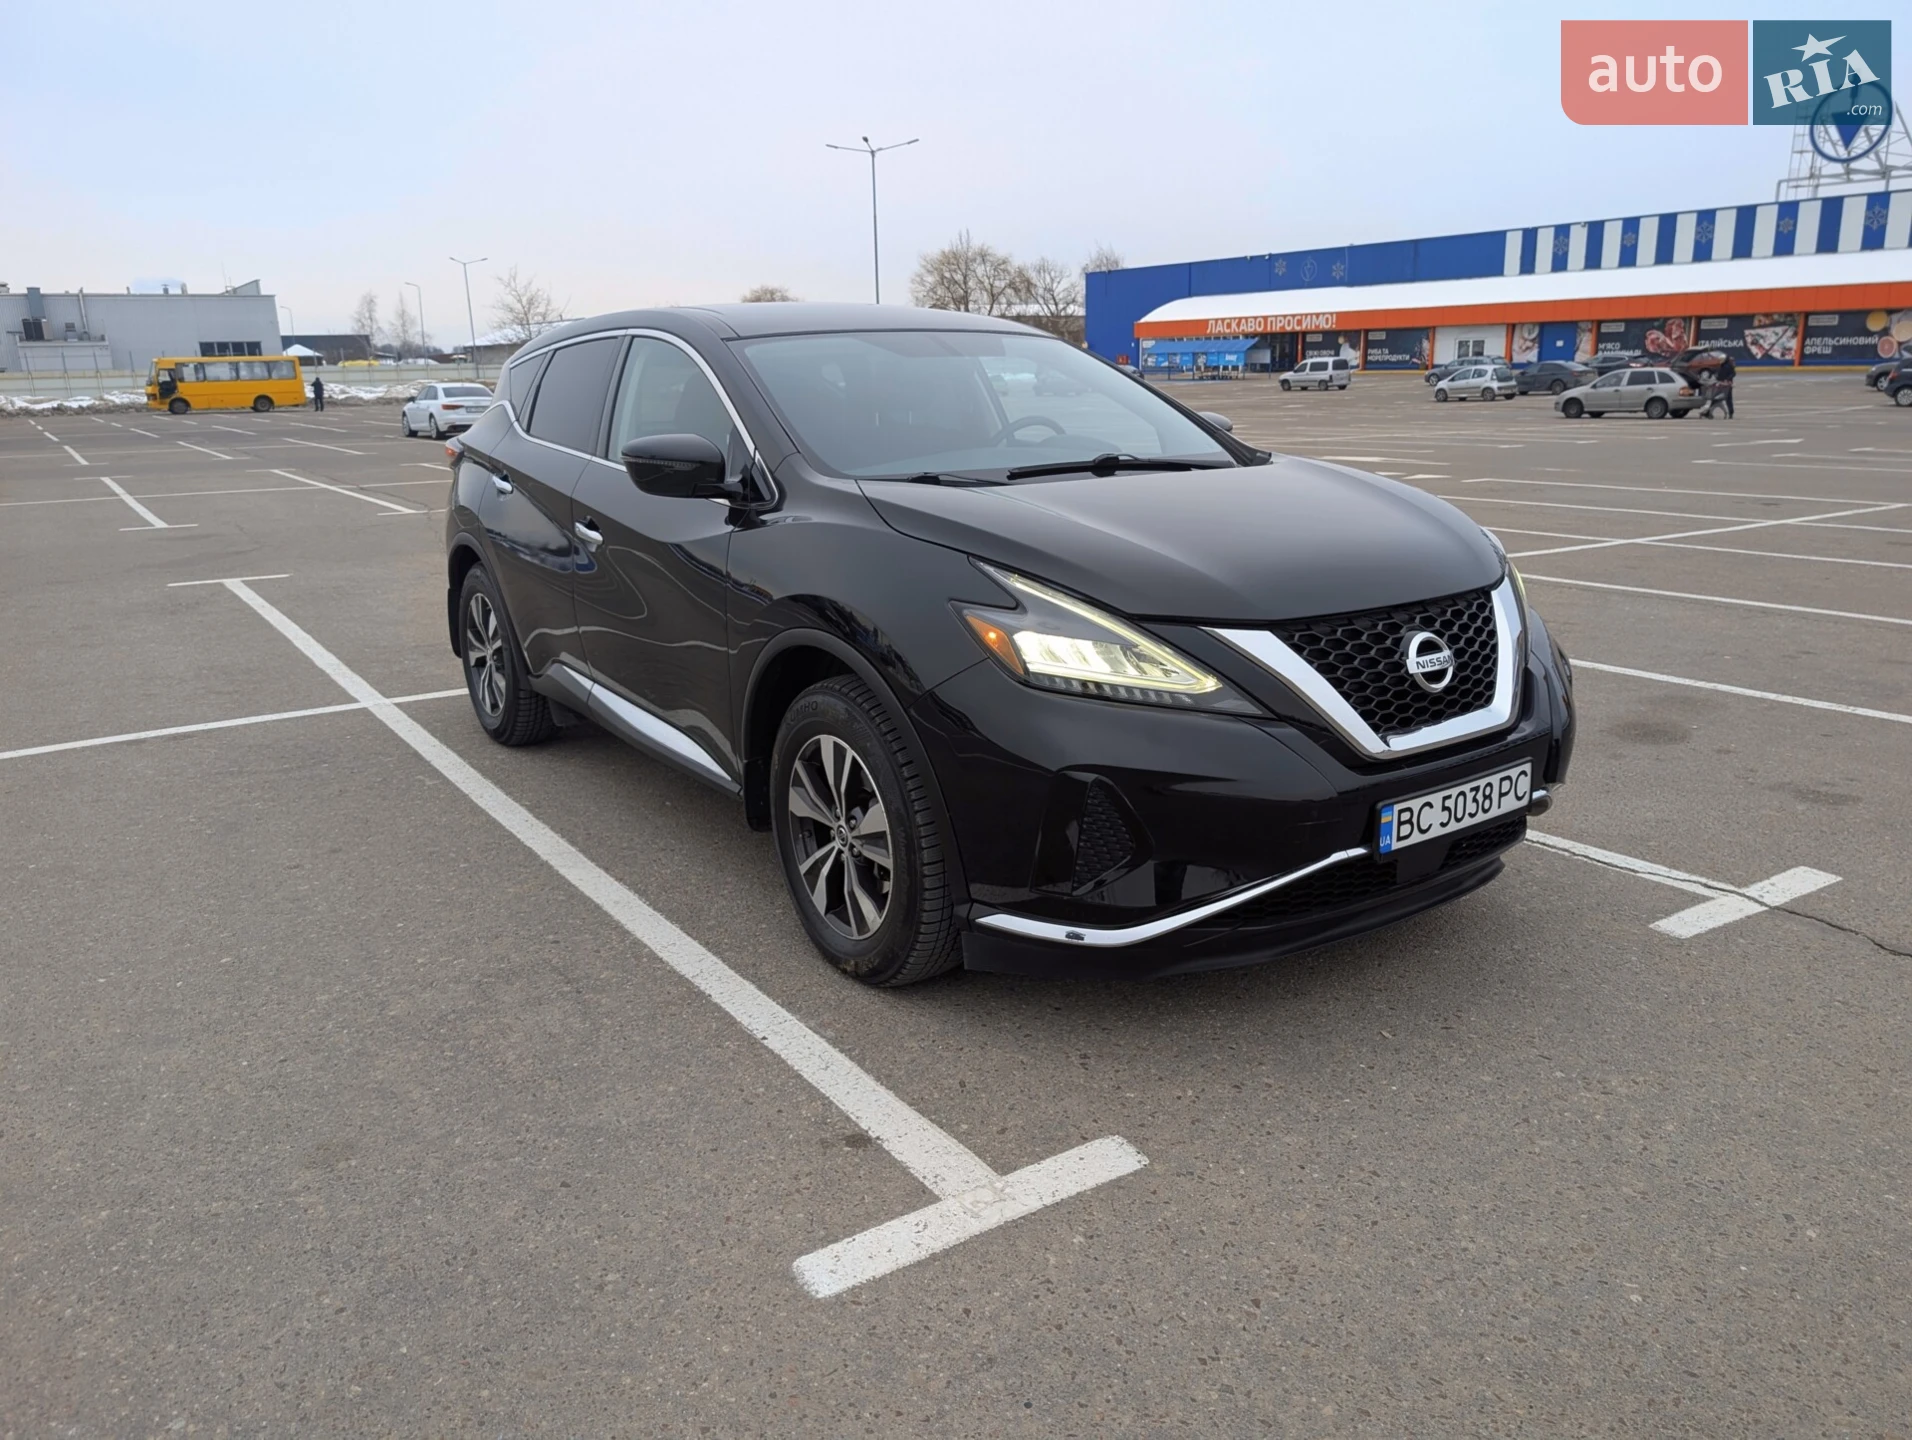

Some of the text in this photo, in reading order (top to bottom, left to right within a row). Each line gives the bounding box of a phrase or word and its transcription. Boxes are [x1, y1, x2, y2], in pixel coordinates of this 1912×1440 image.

[1206, 313, 1336, 334] ЛАСКАВО ПРОСИМО!
[1598, 342, 1621, 350] М'ЯСО
[1698, 337, 1744, 348] ІТАЛІЙСЬКА
[1804, 335, 1879, 346] АПЕЛЬСИНОВИЙ
[1803, 346, 1833, 355] ФРЕШ
[1367, 354, 1410, 362] МОРЕПРОДУКТИ
[1415, 654, 1454, 670] NISSAN
[1396, 769, 1529, 843] BC 5038 PC
[1379, 836, 1391, 847] UA
